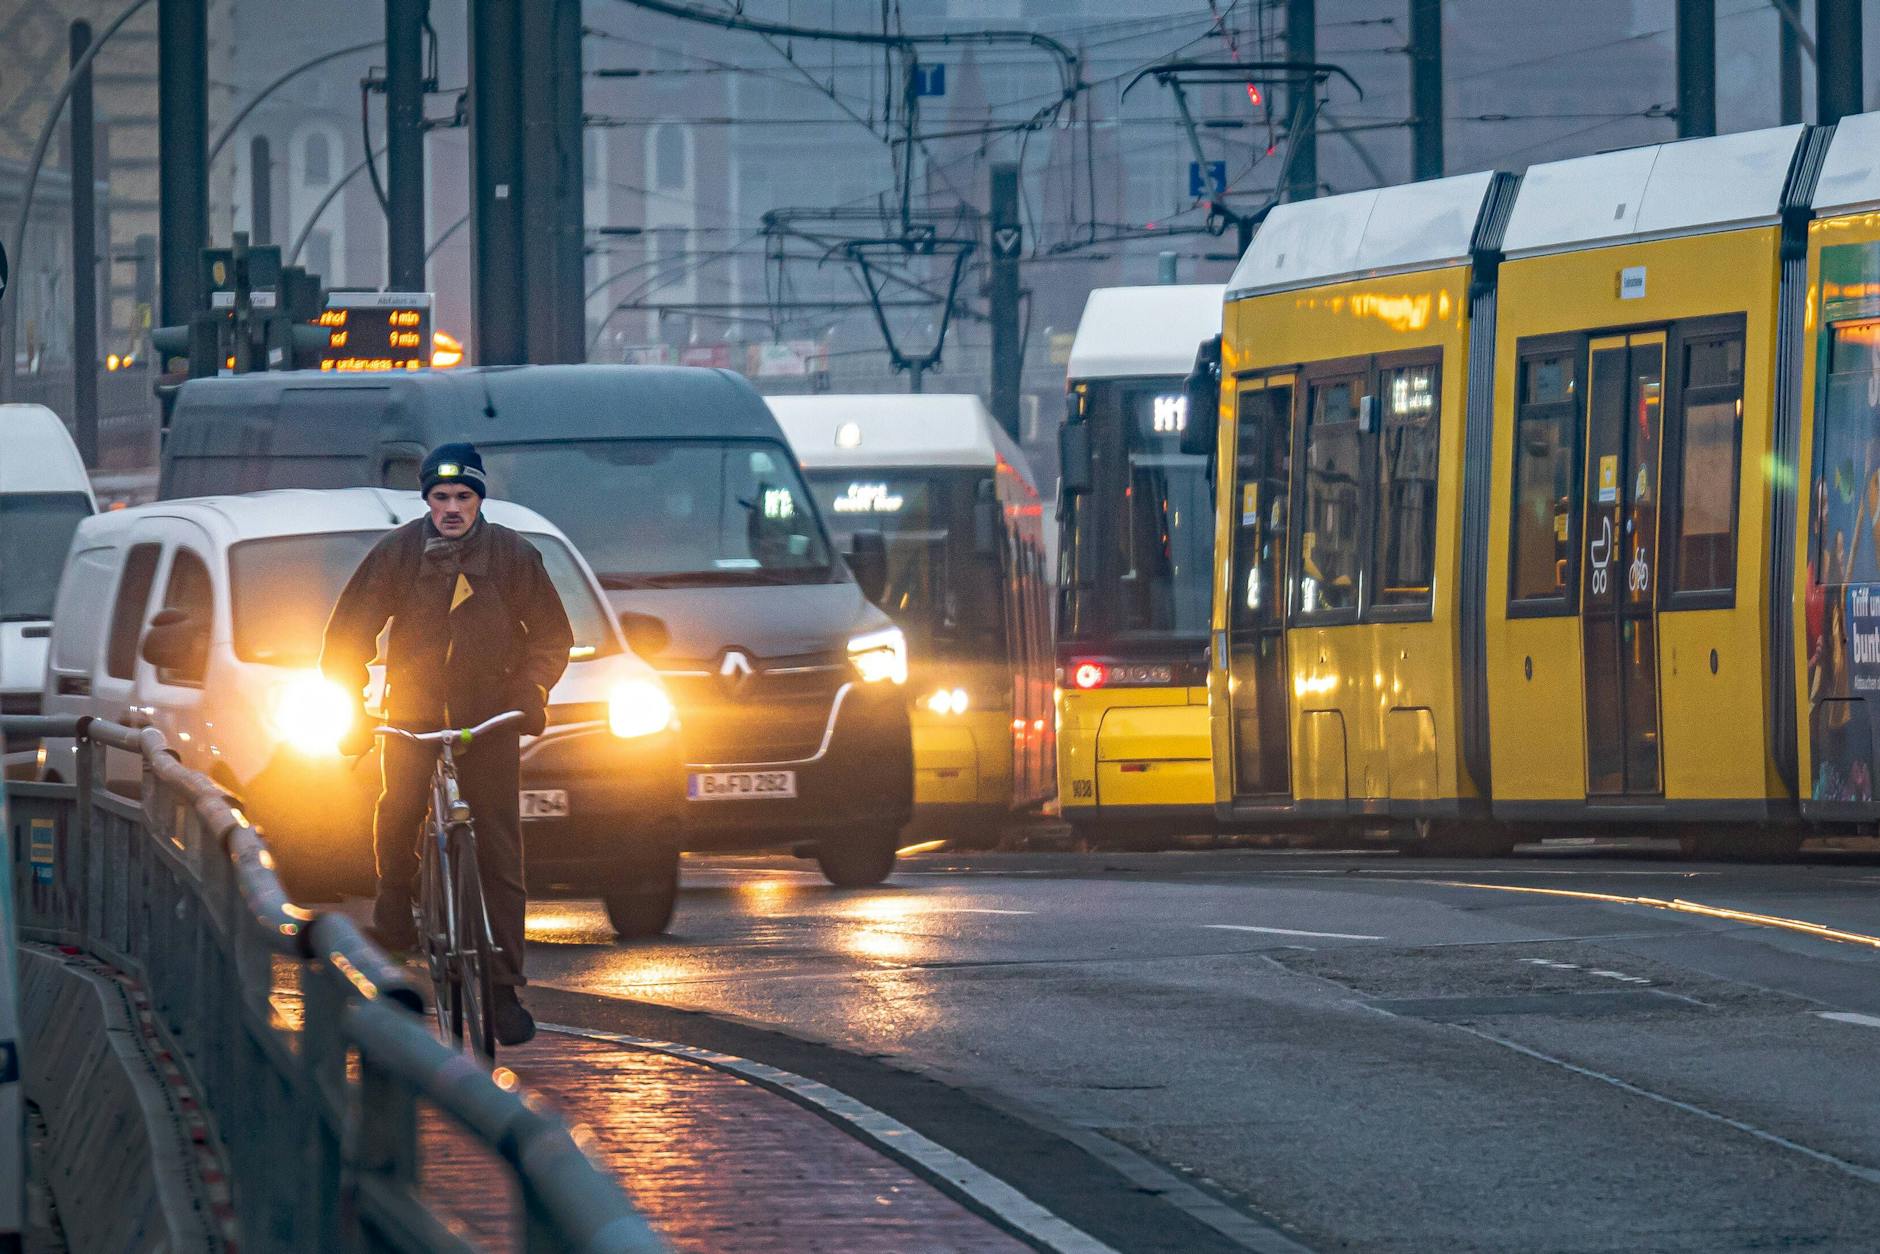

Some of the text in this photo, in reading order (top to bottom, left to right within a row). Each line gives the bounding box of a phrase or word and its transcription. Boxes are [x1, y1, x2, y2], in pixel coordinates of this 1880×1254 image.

[389, 310, 420, 327] 4 min
[398, 331, 420, 347] min
[1852, 587, 1869, 617] Triff
